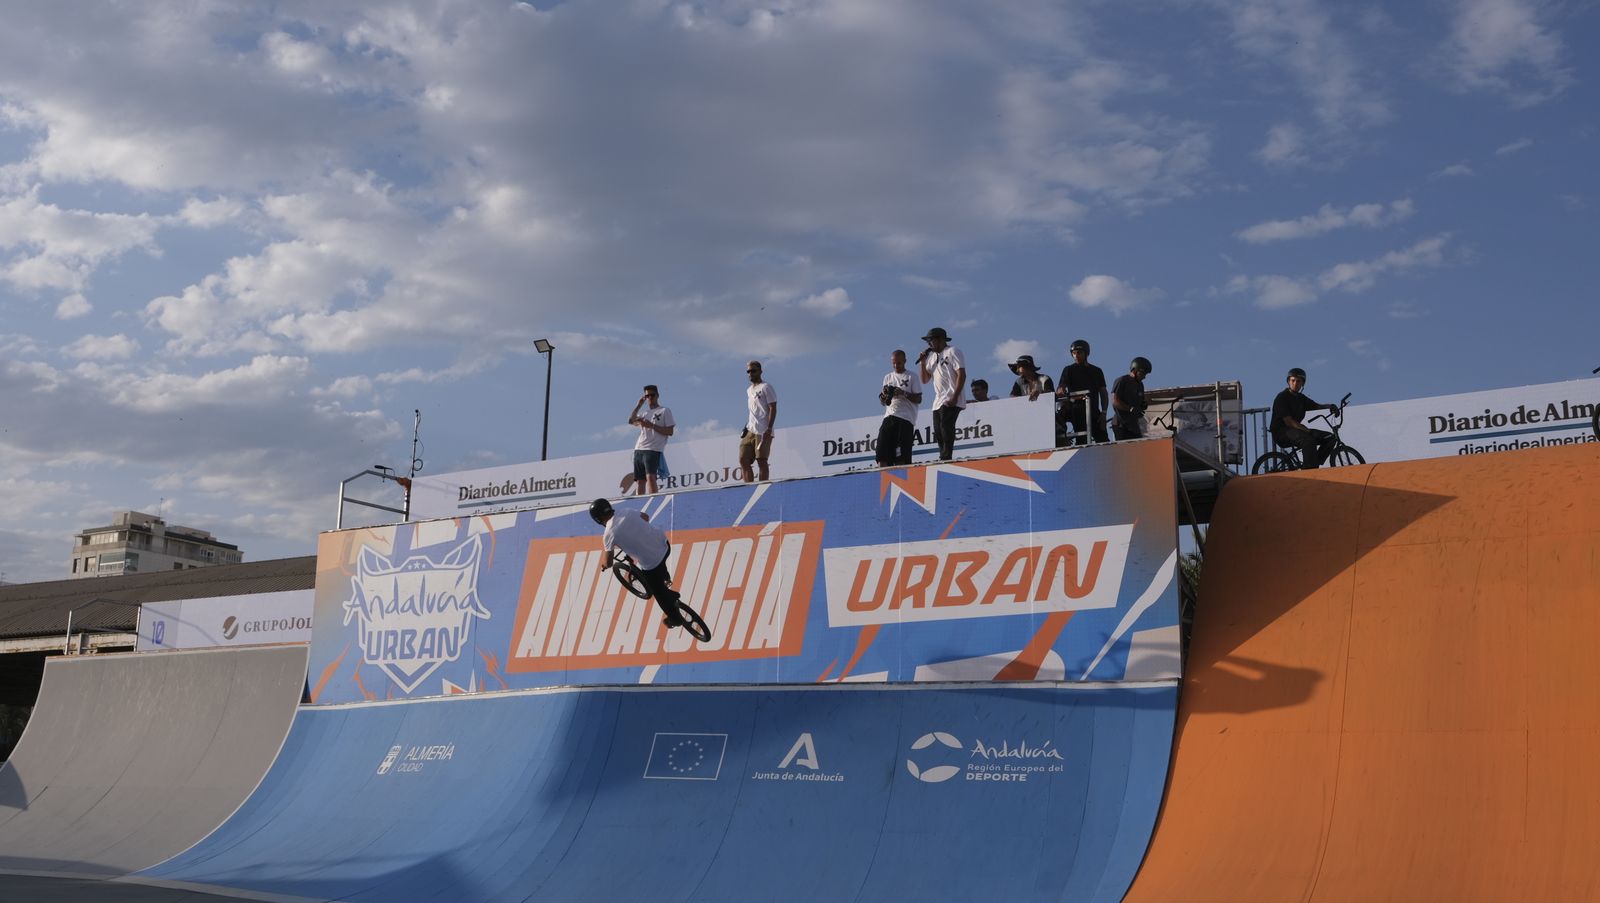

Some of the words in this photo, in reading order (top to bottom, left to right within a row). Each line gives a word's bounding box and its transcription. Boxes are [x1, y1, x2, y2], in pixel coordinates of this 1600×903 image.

[1428, 408, 1508, 434] Diario
[1510, 404, 1541, 426] de
[458, 482, 500, 501] Diario
[501, 480, 518, 498] de
[518, 472, 576, 494] Almería
[514, 520, 806, 658] ANDALUCÍA
[846, 540, 1109, 613] URBAN
[343, 571, 490, 624] Andalucía
[366, 626, 460, 661] URBAN
[404, 742, 455, 761] ALMERÍA
[970, 739, 1064, 760] Andalucía
[752, 772, 780, 780] Junta
[781, 772, 794, 781] de
[795, 772, 844, 782] Andalucía
[965, 772, 1028, 782] DEPORTE
[967, 763, 1000, 773] Región
[1004, 764, 1045, 774] Europea
[1048, 764, 1064, 772] del
